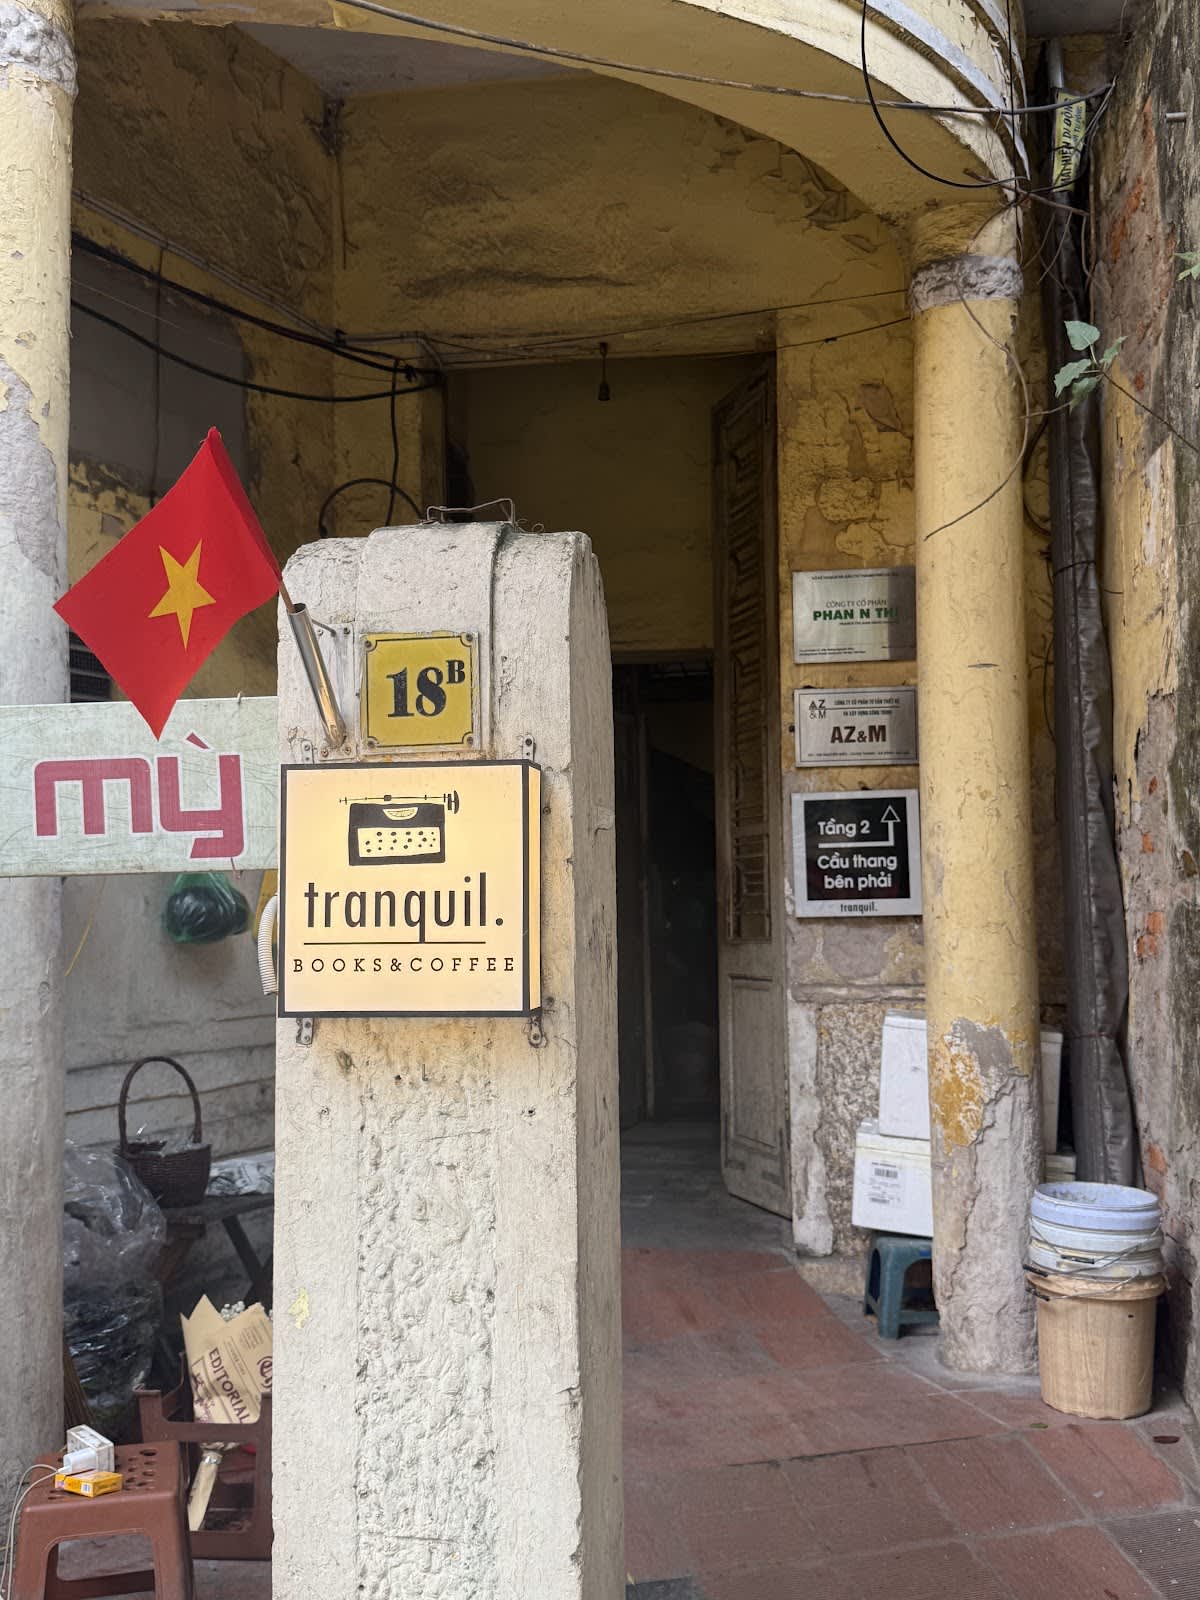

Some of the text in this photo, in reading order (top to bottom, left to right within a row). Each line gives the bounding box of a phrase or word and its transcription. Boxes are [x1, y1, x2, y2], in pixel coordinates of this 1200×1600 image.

[813, 608, 855, 621] PHAN
[859, 608, 871, 619] N
[830, 724, 887, 744] AZ&M
[34, 732, 245, 859] mỳ
[817, 818, 870, 838] Tầng 2
[817, 852, 897, 871] Cầu thang
[824, 871, 892, 891] bên phải
[208, 1347, 251, 1424] EDITORIAL
